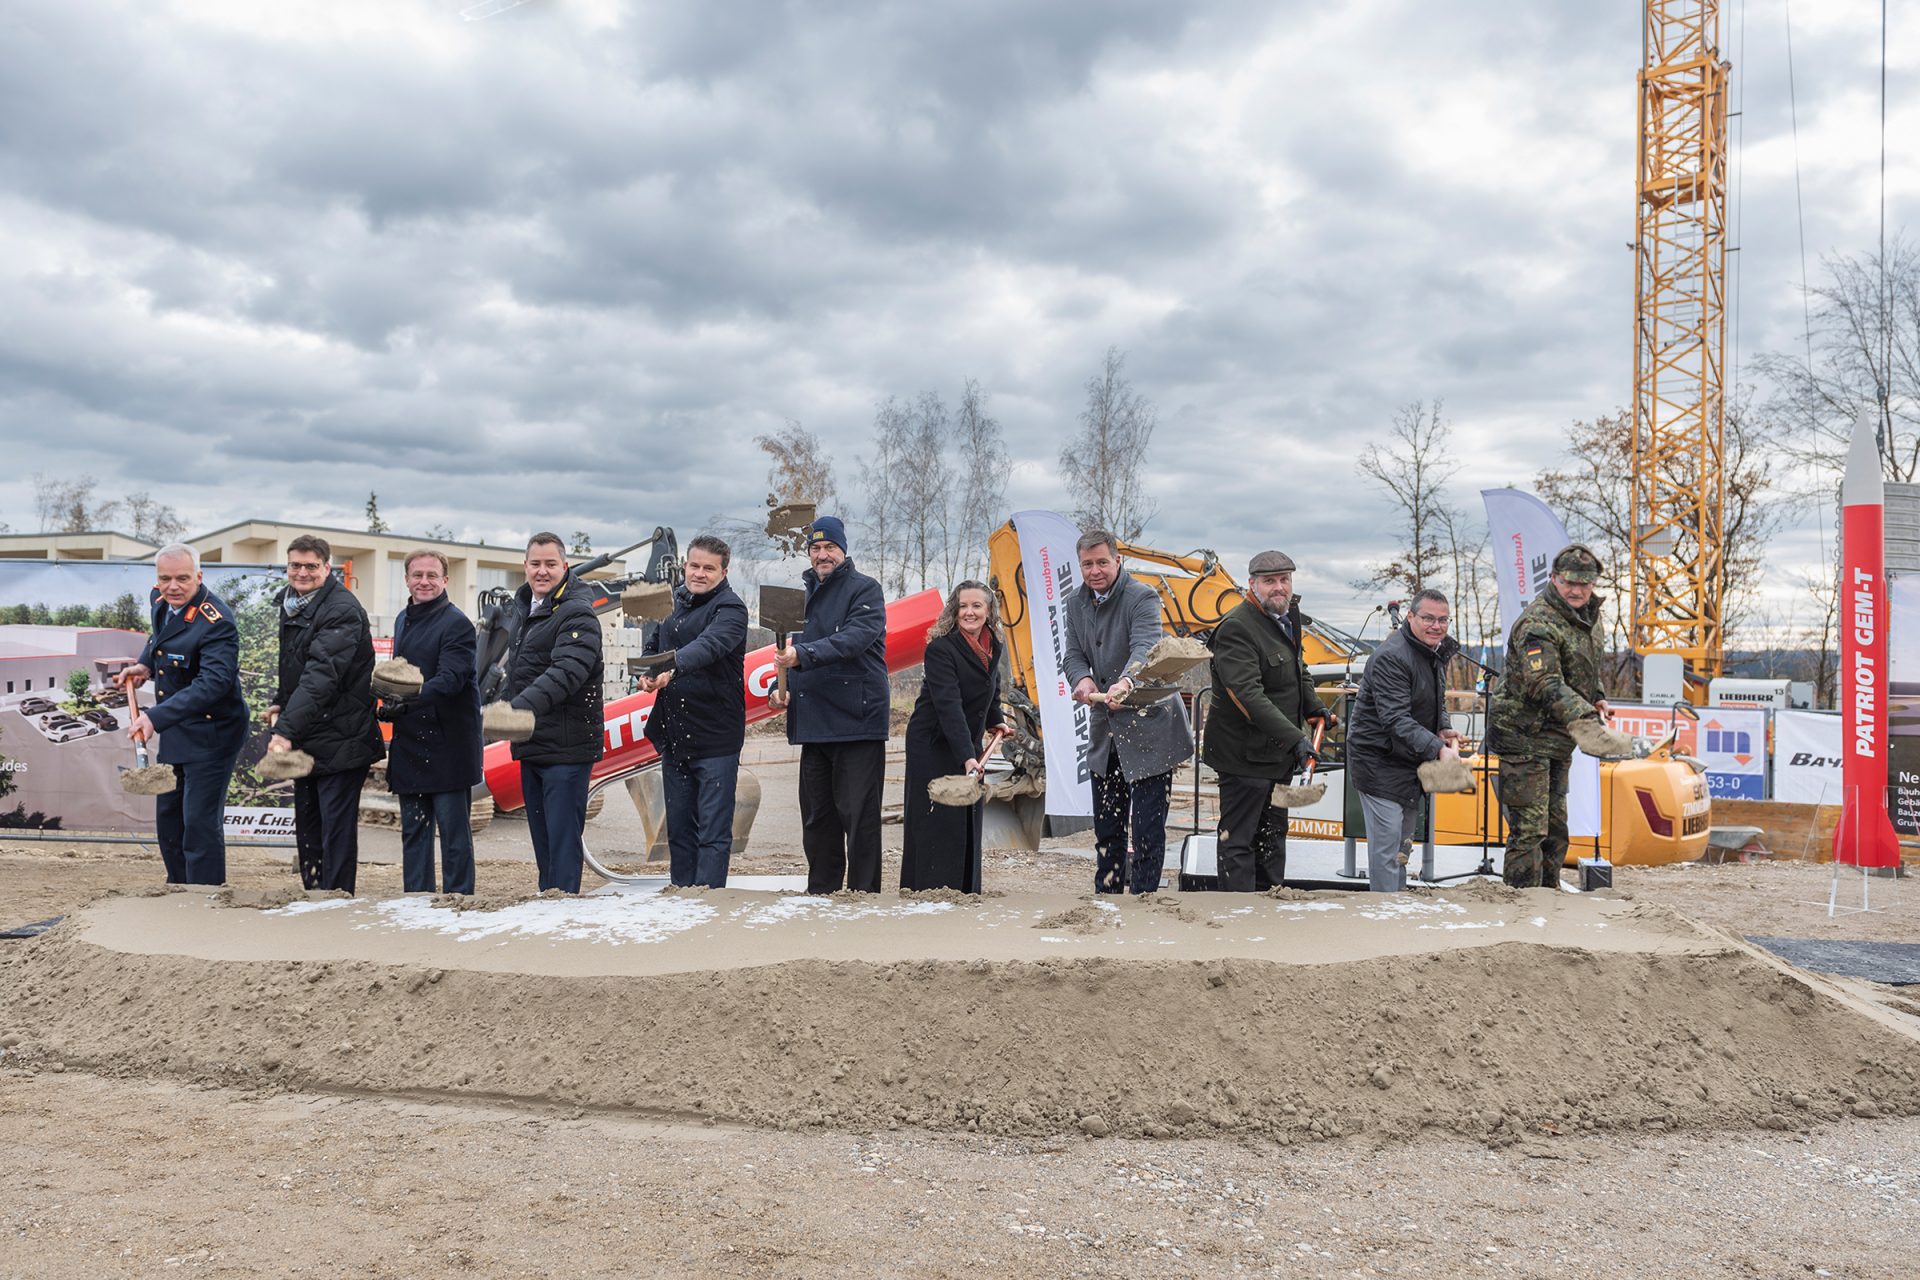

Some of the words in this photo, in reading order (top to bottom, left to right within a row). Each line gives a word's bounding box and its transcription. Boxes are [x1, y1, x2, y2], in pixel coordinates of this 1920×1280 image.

[1854, 567, 1874, 646] GEM-T
[1719, 693, 1774, 702] LIEBHERR
[1856, 651, 1875, 758] PATRIOT
[1790, 752, 1843, 768] BAY
